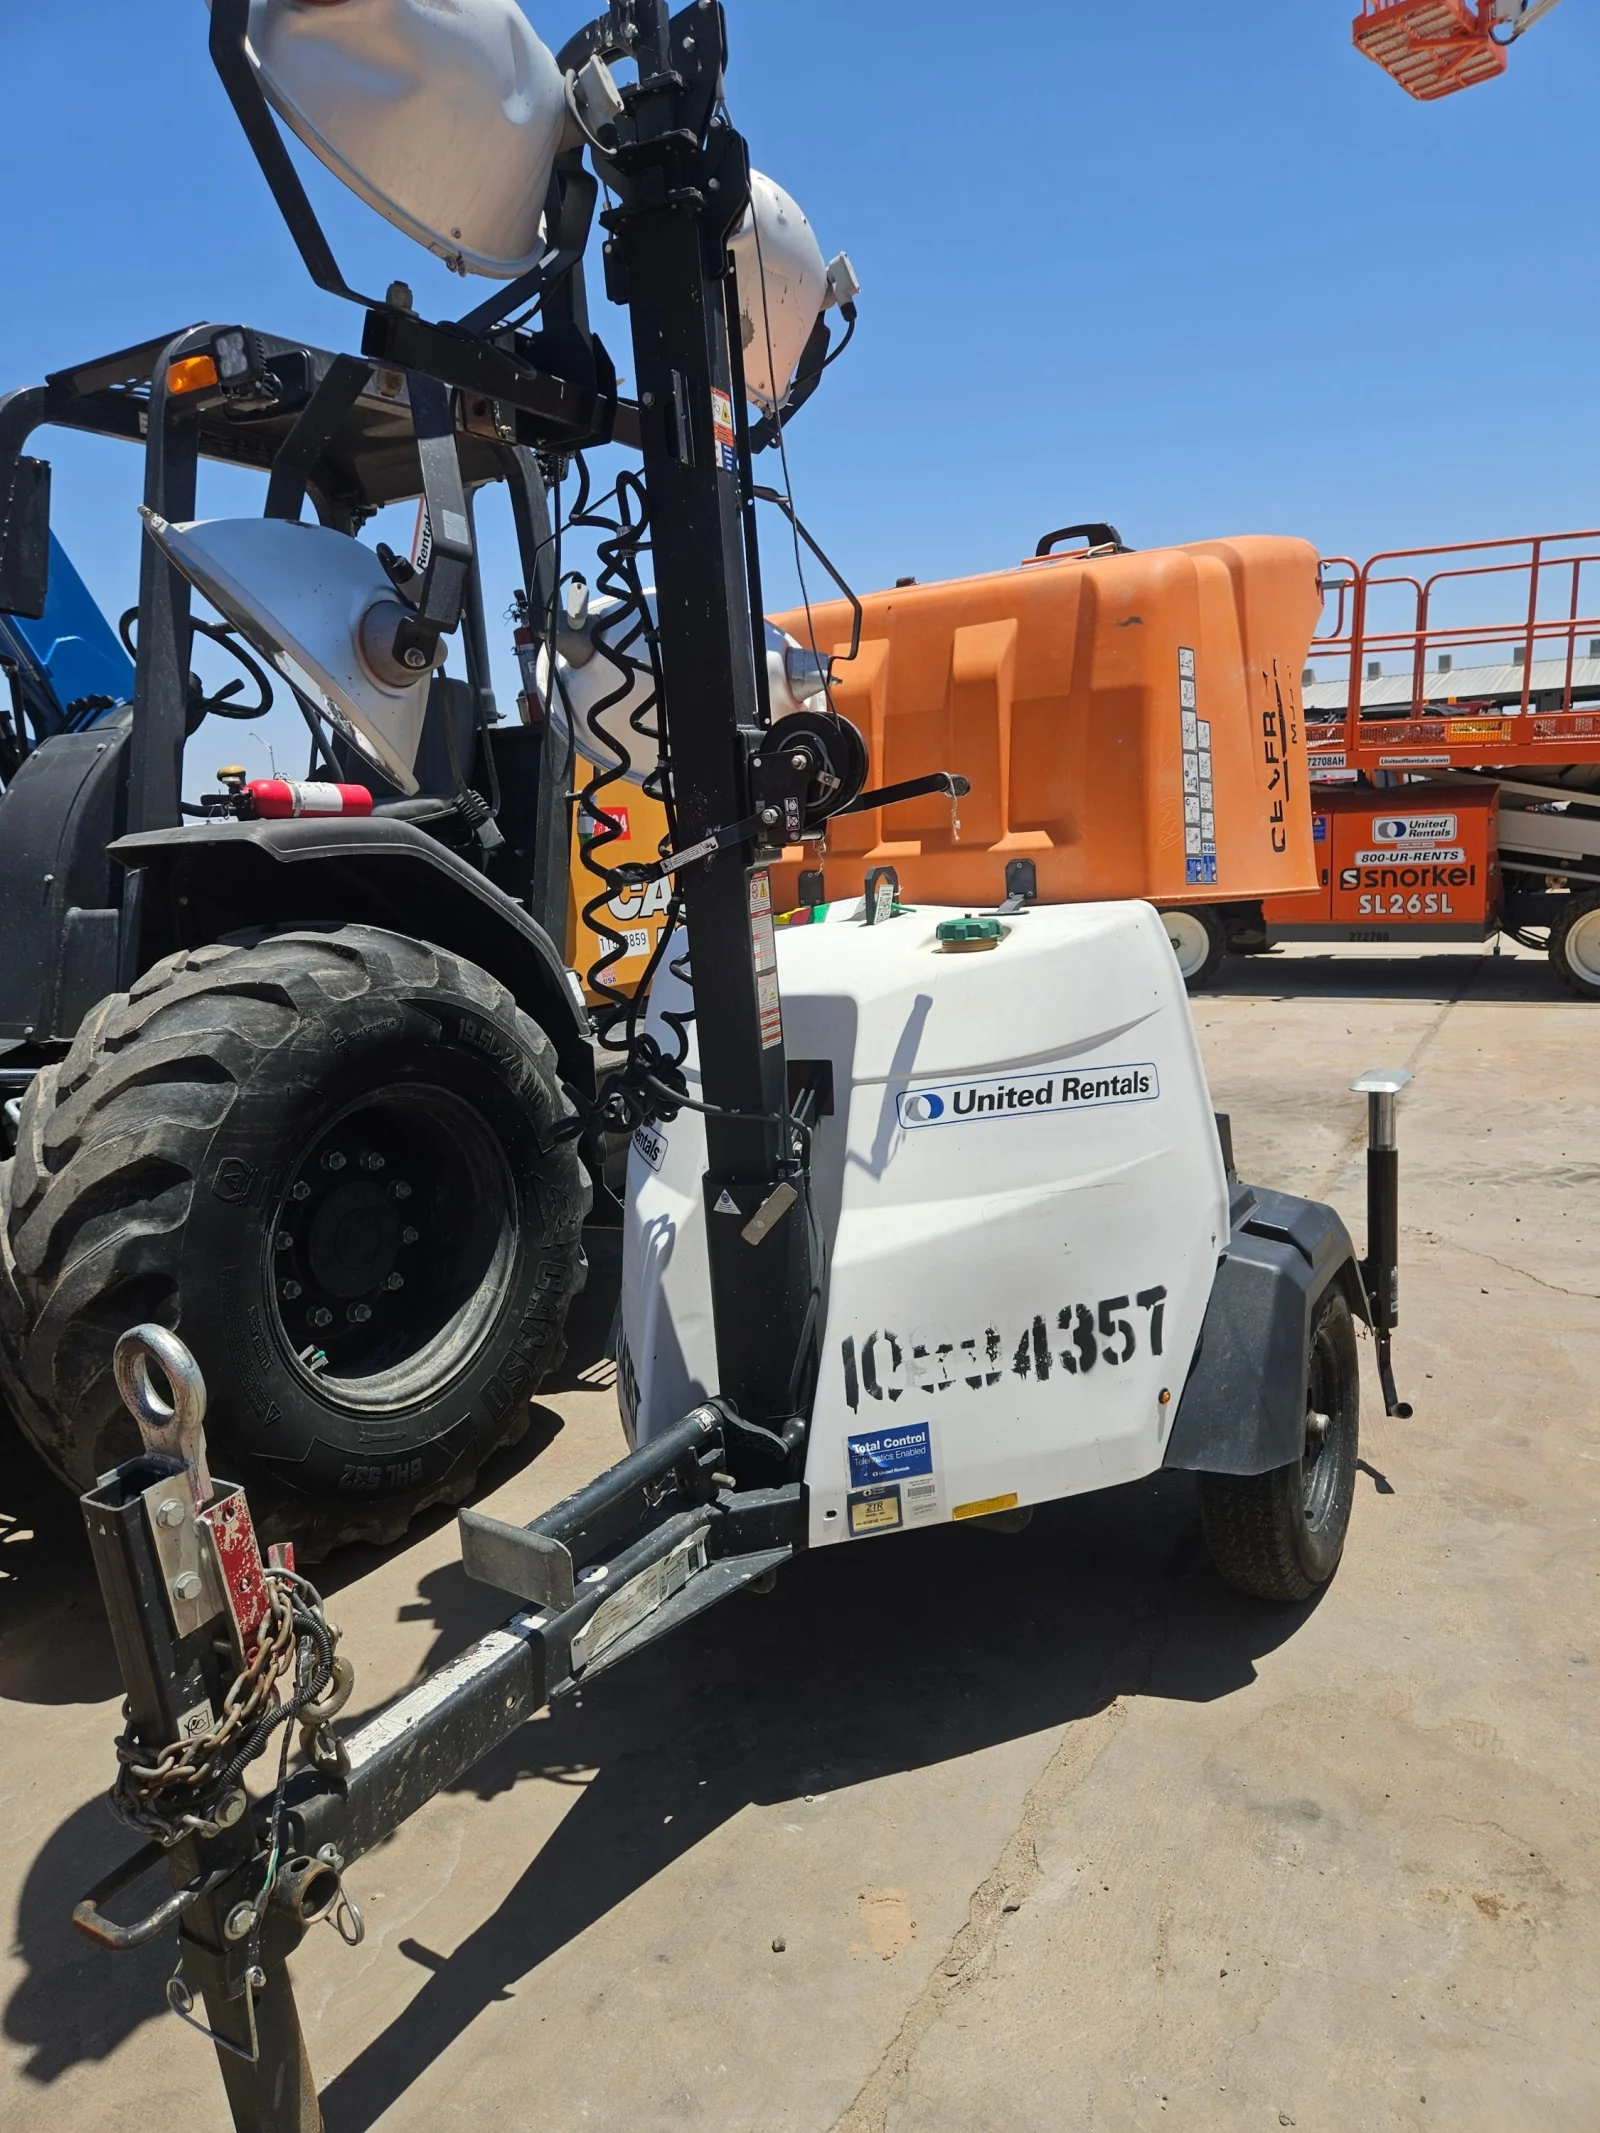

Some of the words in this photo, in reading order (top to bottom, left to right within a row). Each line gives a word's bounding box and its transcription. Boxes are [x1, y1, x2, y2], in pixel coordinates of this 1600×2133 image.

[1380, 756, 1450, 765] UnitedRentals.com
[1408, 819, 1448, 829] United
[1408, 828, 1451, 838] Rentals
[1361, 850, 1460, 863] 800-UR-RENTS
[1364, 864, 1476, 888] snorkel
[606, 874, 686, 920] CA
[1358, 893, 1454, 915] SL26SL
[953, 1080, 1054, 1115] United
[1061, 1071, 1151, 1102] Rentals
[634, 1128, 660, 1162] entals
[851, 1440, 881, 1454] Total
[883, 1432, 926, 1448] Control
[895, 1446, 927, 1459] Enabled
